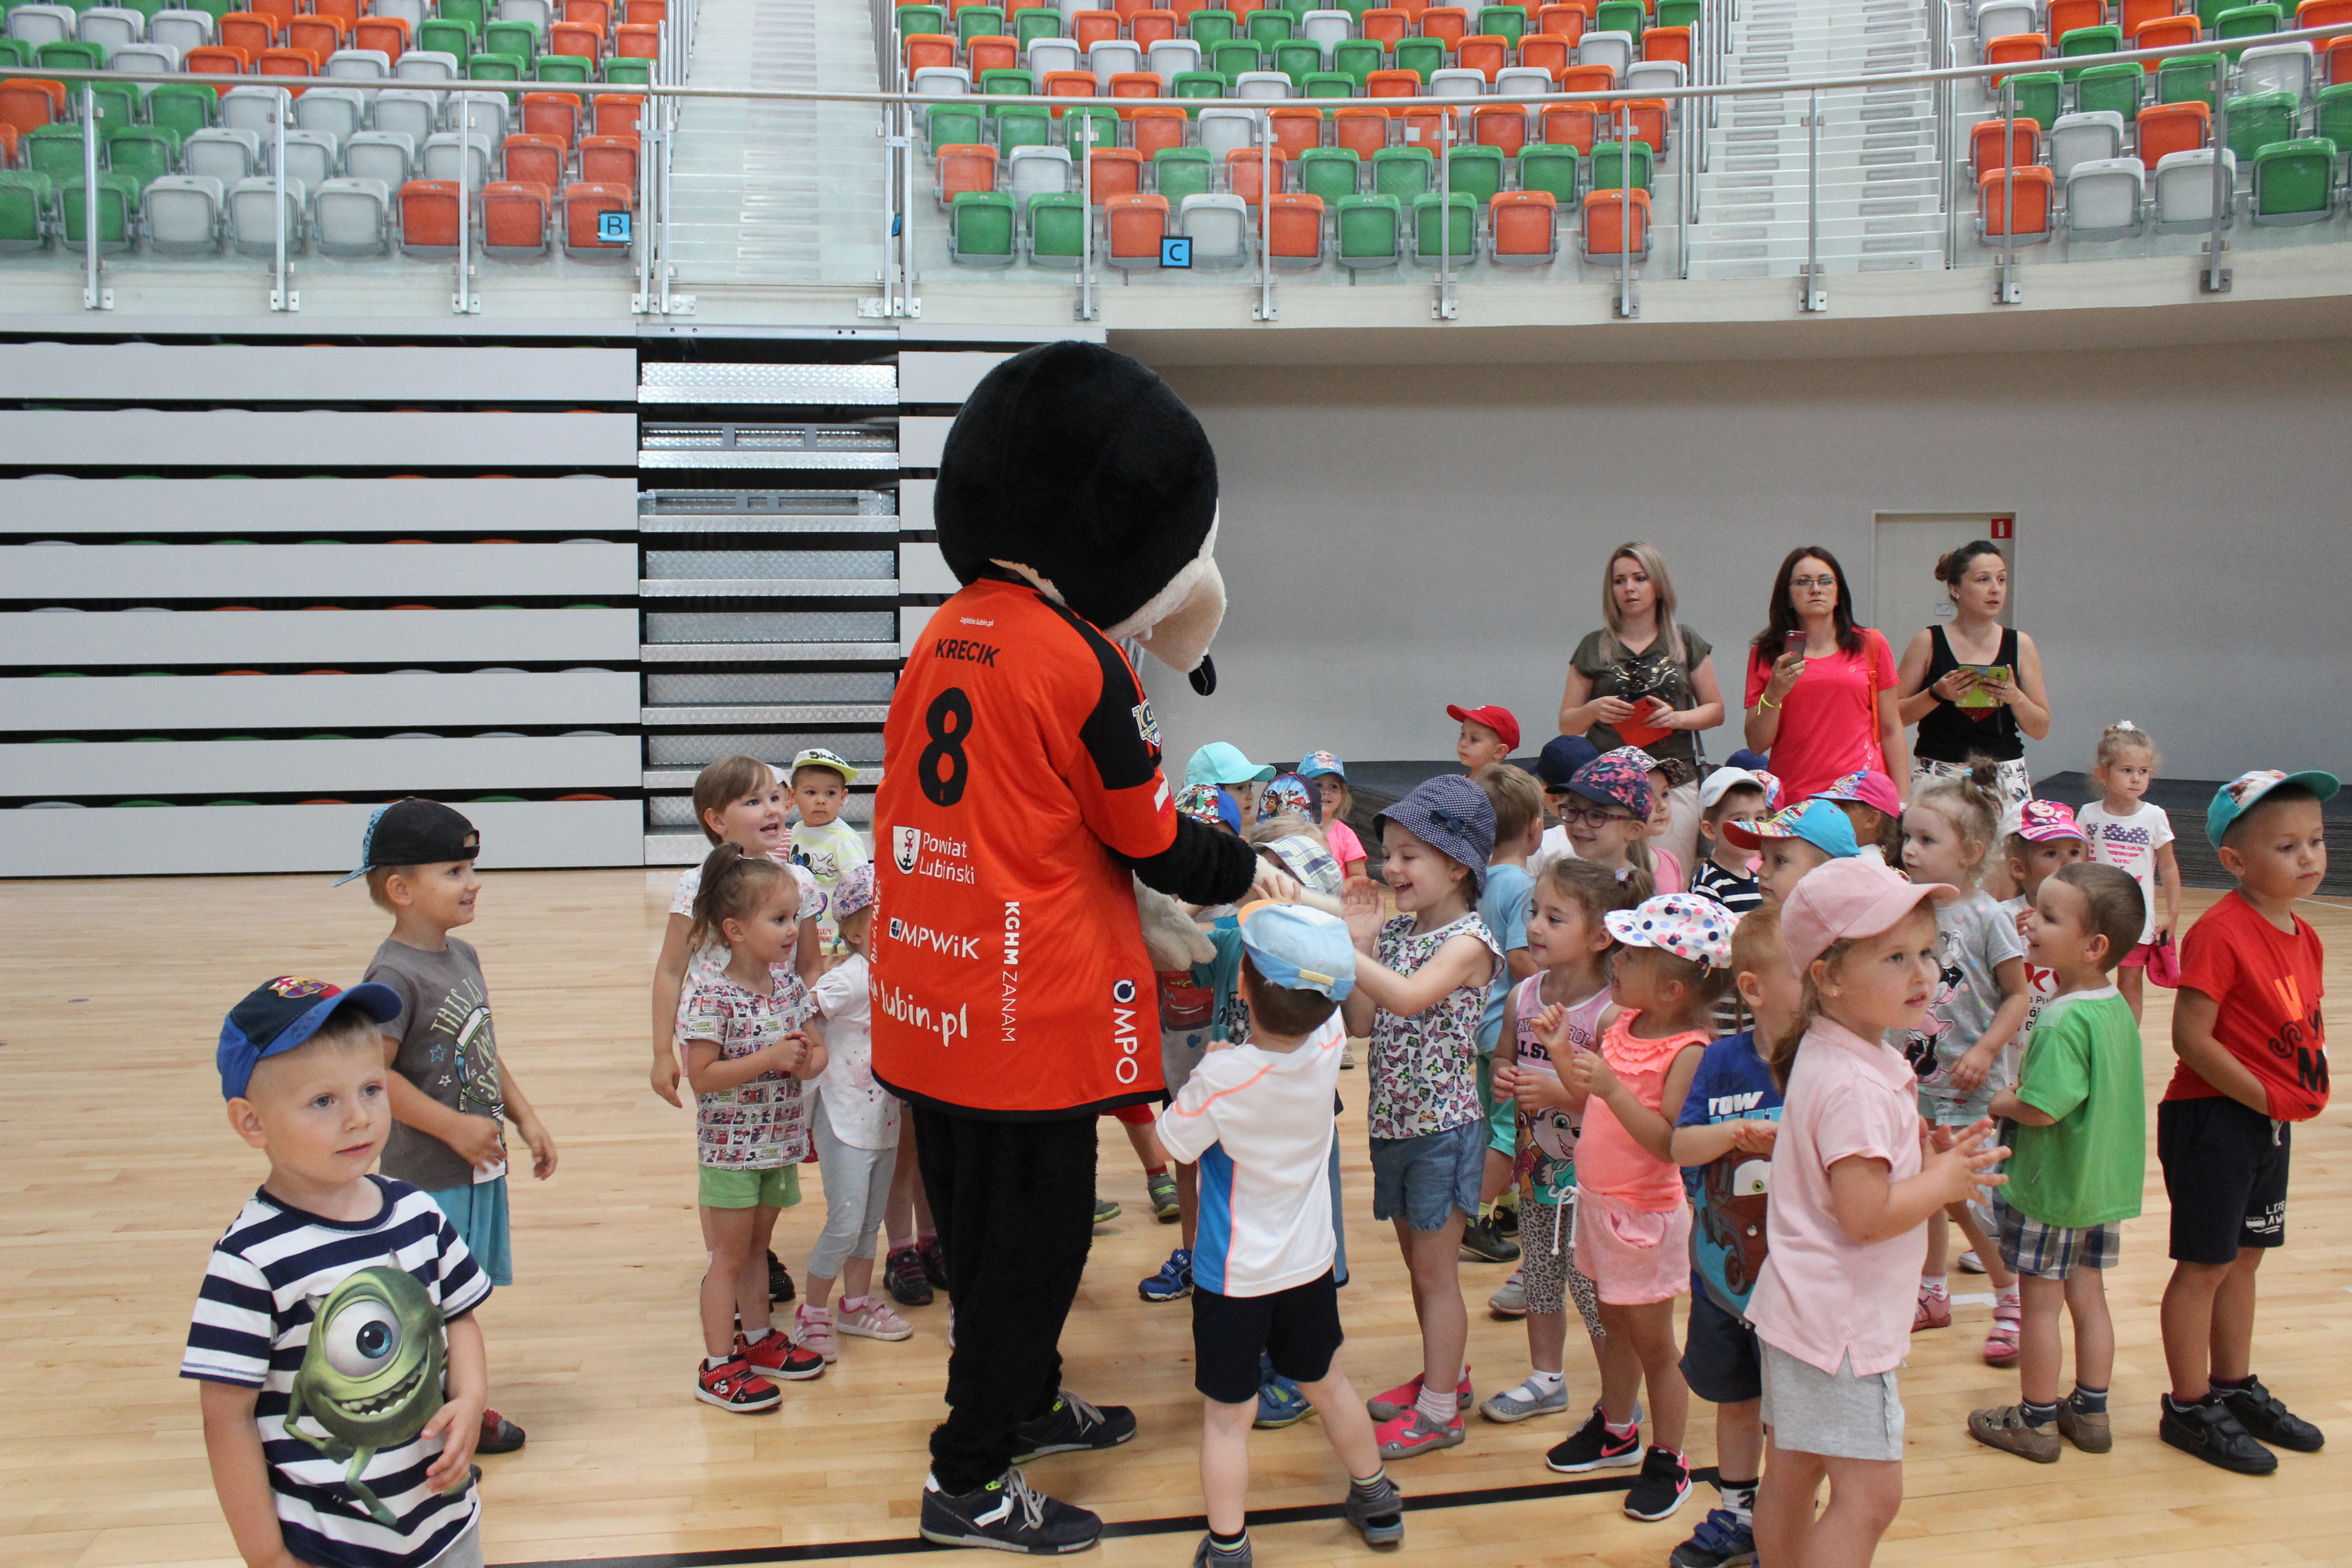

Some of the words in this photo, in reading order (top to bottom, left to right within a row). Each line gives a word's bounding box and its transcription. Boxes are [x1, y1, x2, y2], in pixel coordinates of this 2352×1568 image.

[608, 216, 622, 235] B
[1169, 244, 1182, 261] C
[935, 639, 1001, 668] KRECIK
[918, 687, 972, 806] 8
[922, 832, 967, 858] Powiat
[919, 856, 975, 885] Lubiński
[900, 921, 980, 960] MPWiK
[1004, 902, 1020, 965] KGHM
[430, 989, 472, 1035] THIS
[462, 977, 483, 1004] IS
[1001, 971, 1018, 1042] ZANAM
